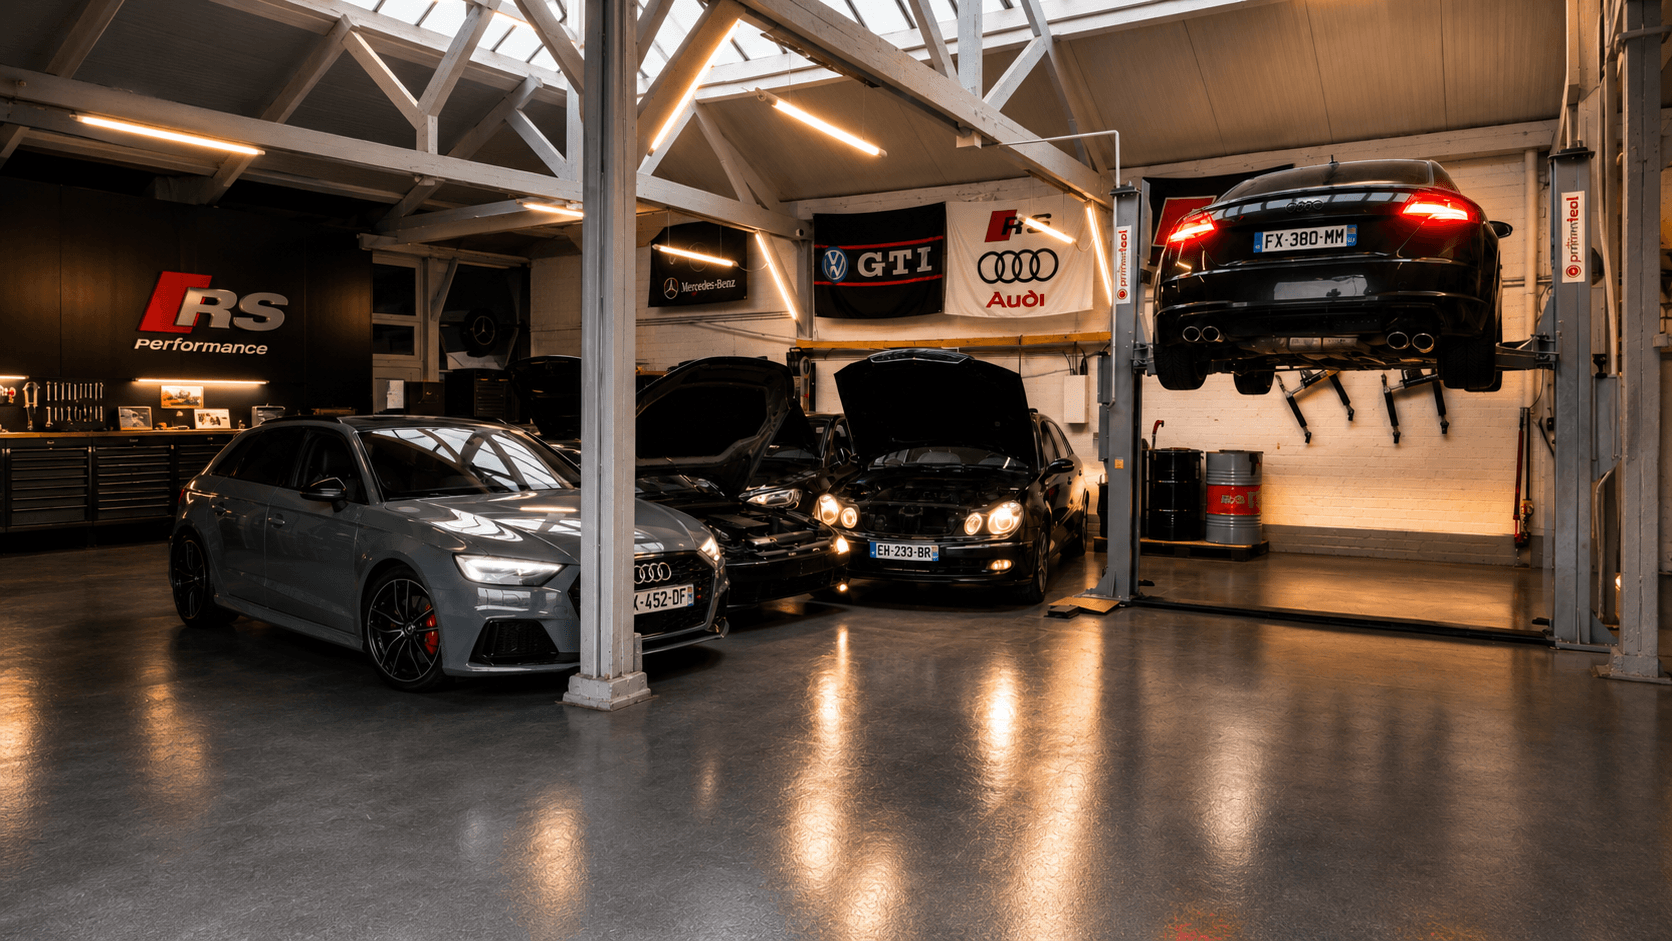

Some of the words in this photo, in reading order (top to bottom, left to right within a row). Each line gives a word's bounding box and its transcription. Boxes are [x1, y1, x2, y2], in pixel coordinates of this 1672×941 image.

[1265, 228, 1345, 249] FX-380-MM
[857, 246, 932, 278] GTI
[681, 279, 736, 293] Mercedes-Benz
[174, 286, 289, 332] RS
[986, 290, 1045, 309] Audi
[134, 337, 269, 355] Performance
[877, 544, 931, 558] EH-233-BR
